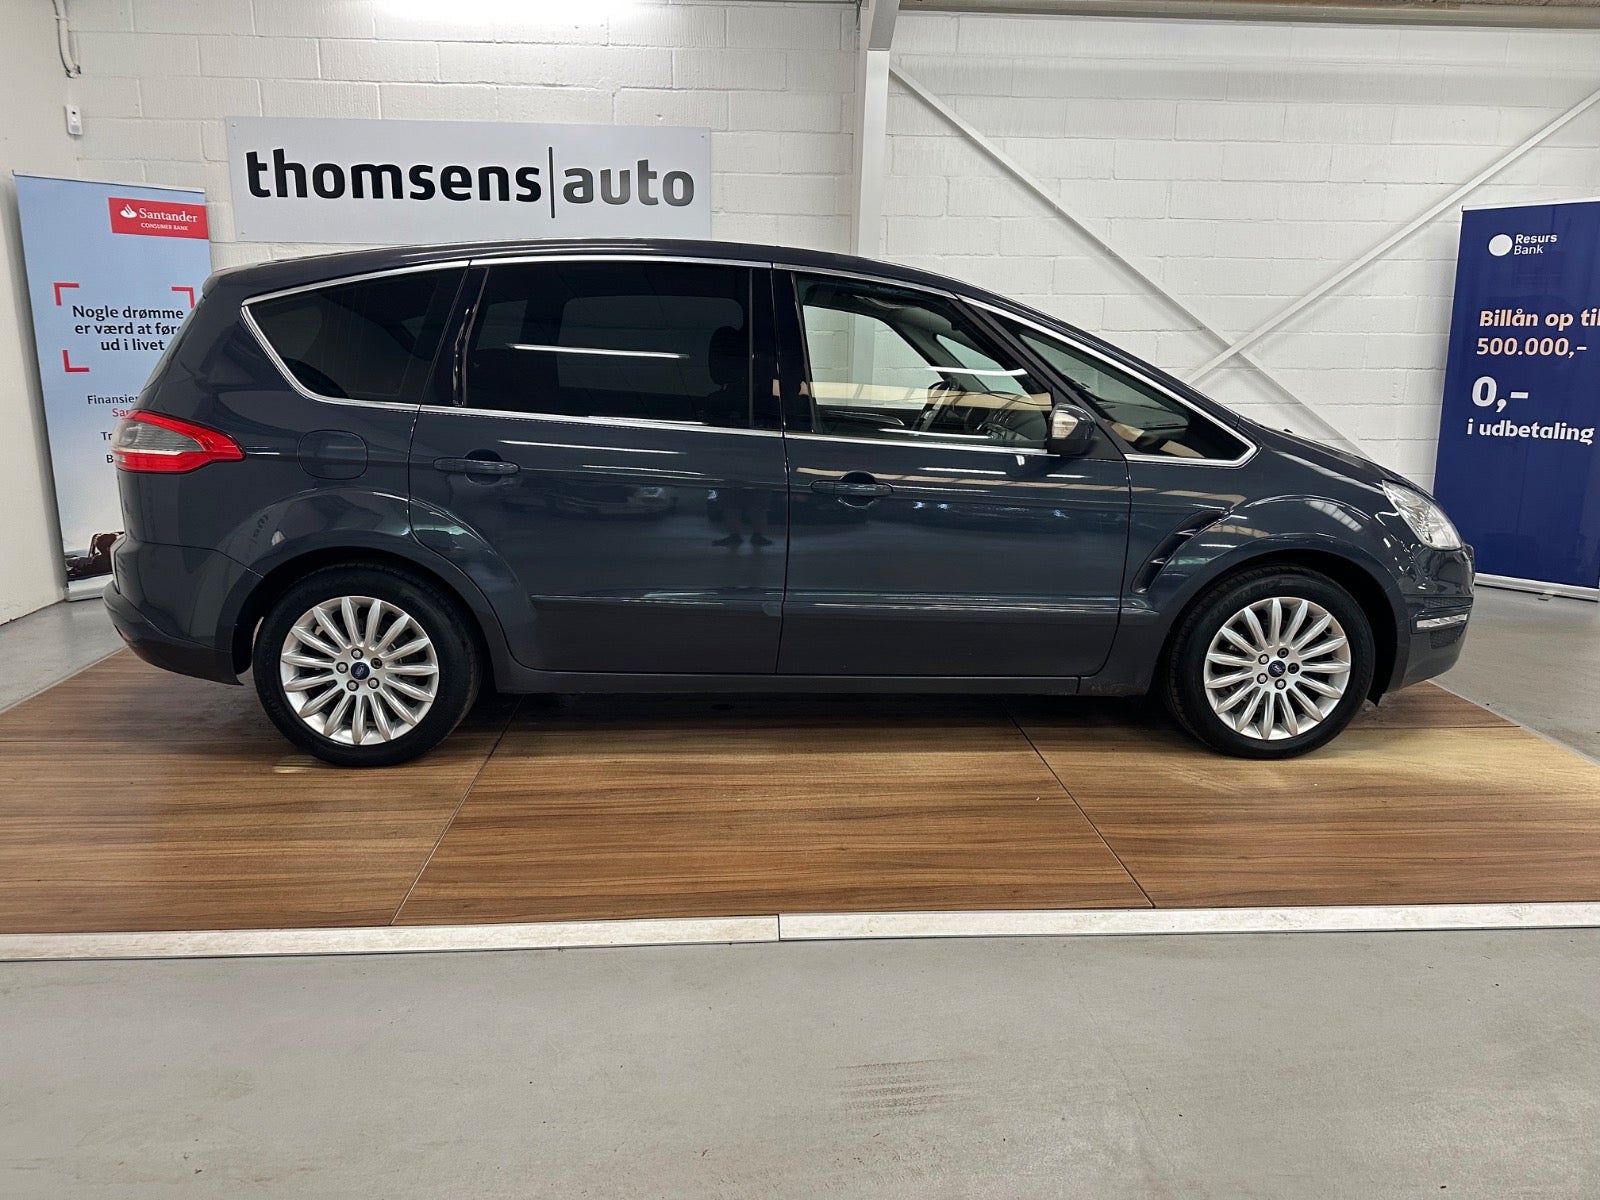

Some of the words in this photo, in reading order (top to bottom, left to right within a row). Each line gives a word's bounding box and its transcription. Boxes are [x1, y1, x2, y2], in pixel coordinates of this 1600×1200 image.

[245, 147, 542, 203] thomsens
[562, 158, 695, 207] auto
[138, 207, 198, 223] Santander
[140, 222, 172, 230] CONSUMER
[1515, 233, 1558, 244] Resurs
[1513, 244, 1544, 255] Bank
[72, 305, 119, 321] Nogle
[122, 306, 184, 319] drømme
[1480, 308, 1539, 327] Billån
[1545, 313, 1574, 331] op
[74, 325, 91, 335] er
[94, 322, 134, 335] værd
[137, 323, 152, 335] at
[100, 338, 120, 351] ud
[124, 339, 128, 351] i
[132, 338, 165, 351] livet
[1466, 418, 1474, 435] i
[1479, 420, 1595, 445] udbetaling
